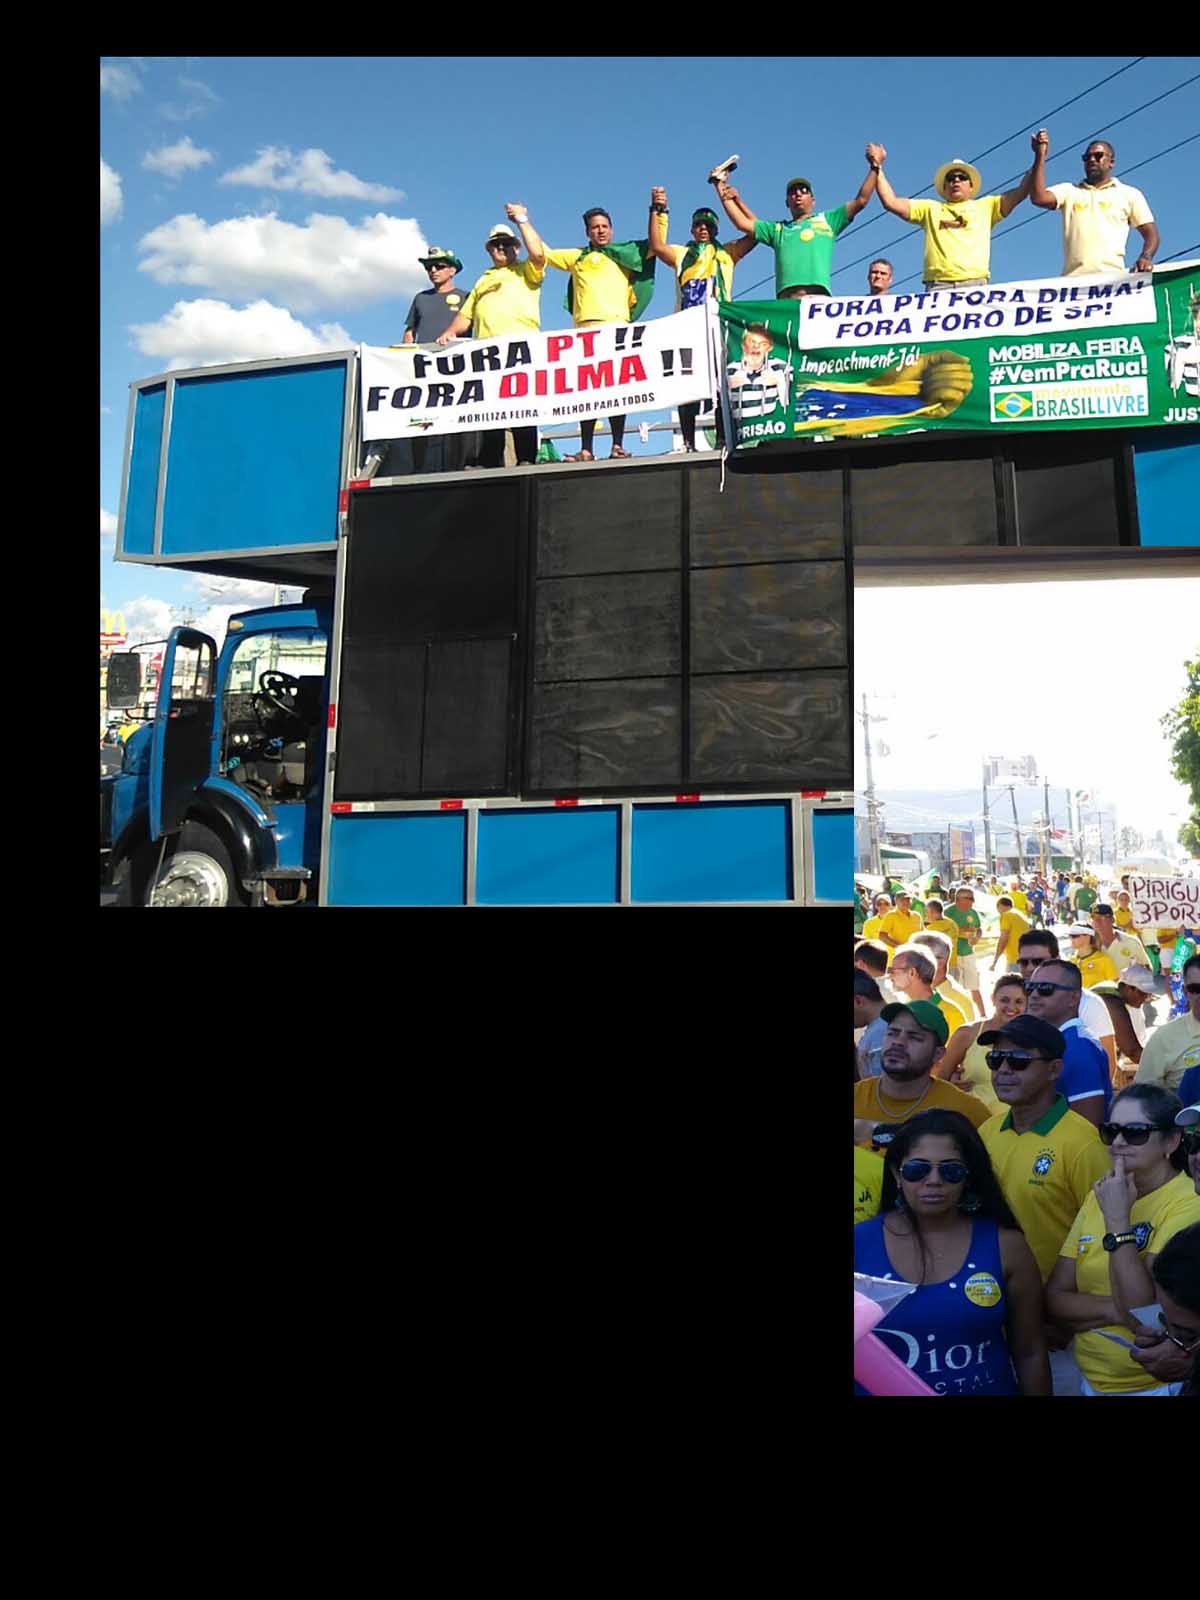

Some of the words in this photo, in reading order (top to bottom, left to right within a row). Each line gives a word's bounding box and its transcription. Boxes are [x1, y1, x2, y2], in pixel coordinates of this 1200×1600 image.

[808, 298, 883, 320] FORA
[894, 292, 939, 313] PT!
[948, 289, 1025, 307] FORA
[1038, 280, 1145, 304] DILMA!
[836, 317, 912, 339] FORA
[923, 310, 1004, 333] FORO
[1014, 306, 1053, 327] DE
[1064, 302, 1113, 320] SP!
[414, 340, 532, 379] FORA
[547, 329, 601, 363] PT
[799, 348, 899, 376] Impeachment
[988, 341, 1081, 363] MOBILIZA
[1086, 335, 1145, 356] FEIRA
[366, 378, 485, 412] FORA
[498, 354, 649, 399] DILMA
[988, 354, 1148, 385] #VemPraRua!
[458, 410, 507, 424] MOBILIZA
[510, 408, 539, 419] FEIRA
[552, 402, 591, 416] MELHOR
[594, 398, 620, 411] PARA
[622, 392, 655, 406] TODOS
[871, 1328, 991, 1373] Dior
